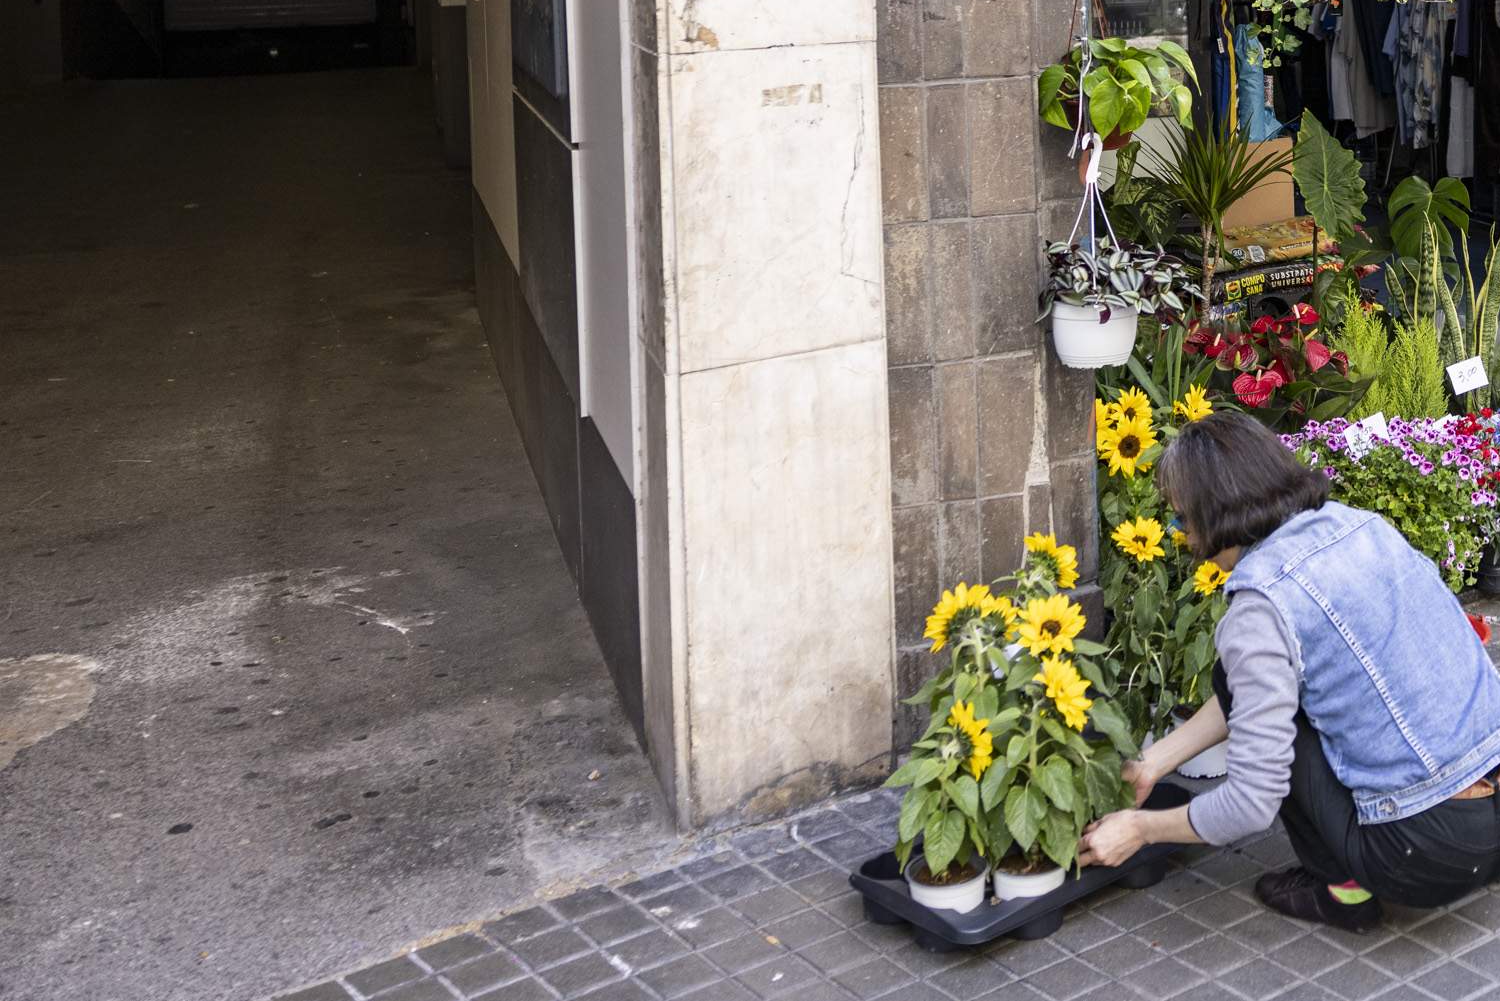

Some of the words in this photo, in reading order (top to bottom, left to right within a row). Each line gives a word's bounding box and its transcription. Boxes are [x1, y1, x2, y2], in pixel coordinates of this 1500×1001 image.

[1270, 268, 1313, 280] SUBSTRATO
[1241, 274, 1265, 287] COMPO
[1246, 285, 1263, 295] SANA
